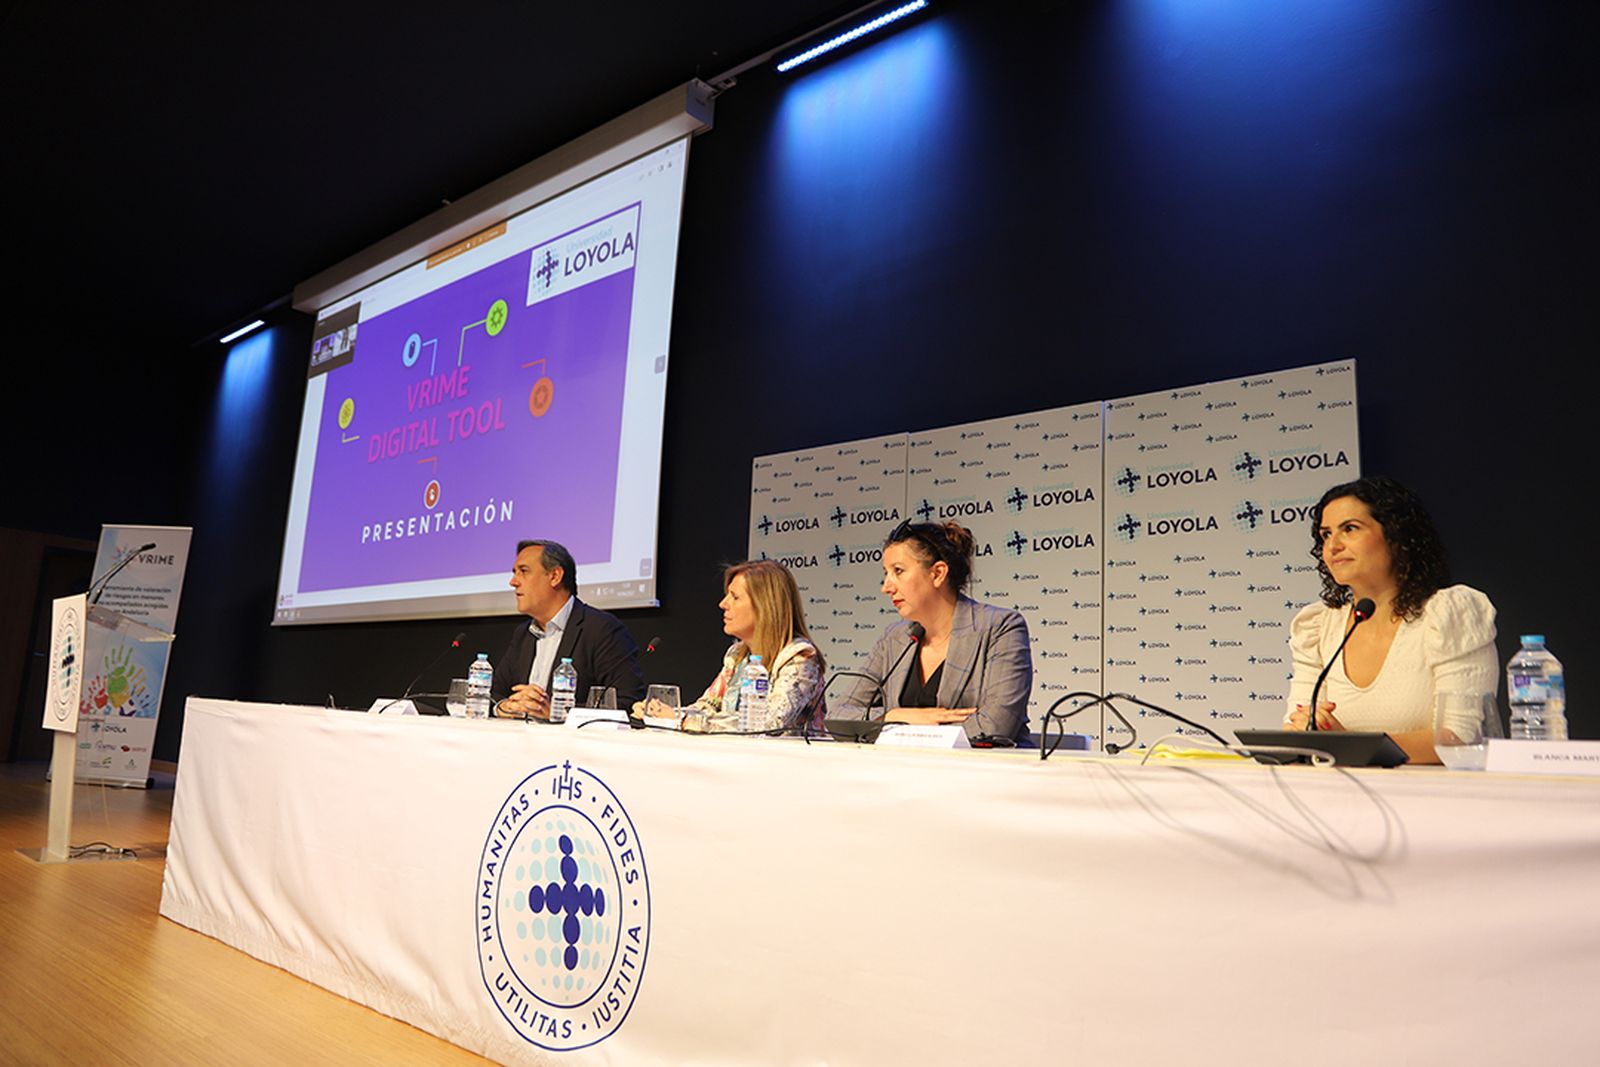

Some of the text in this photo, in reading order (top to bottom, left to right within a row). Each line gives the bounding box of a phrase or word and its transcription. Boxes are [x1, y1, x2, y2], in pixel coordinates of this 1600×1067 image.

[564, 232, 634, 277] LOYOLA
[407, 364, 471, 413] VRIME
[367, 398, 506, 463] DIGITAL TOOL
[1269, 451, 1349, 474] LOYOLA
[1147, 468, 1217, 489] LOYOLA
[1033, 488, 1095, 507] LOYOLA
[851, 508, 900, 524] LOYOLA
[939, 500, 994, 518] LOYOLA
[1270, 506, 1318, 524] LOYO
[361, 498, 514, 544] PRESENTACIÓN
[776, 518, 820, 533] LOYOLA
[1147, 516, 1218, 536] LOYOLA
[1033, 534, 1095, 552] LOYOLA
[139, 554, 175, 566] VRIME
[849, 549, 883, 563] LOYO
[552, 774, 583, 801] IHS
[601, 804, 639, 885] FIDES
[482, 794, 530, 942] HUMANITAS
[592, 926, 642, 1028] IUSTITIA
[495, 972, 573, 1039] UTILITAS
